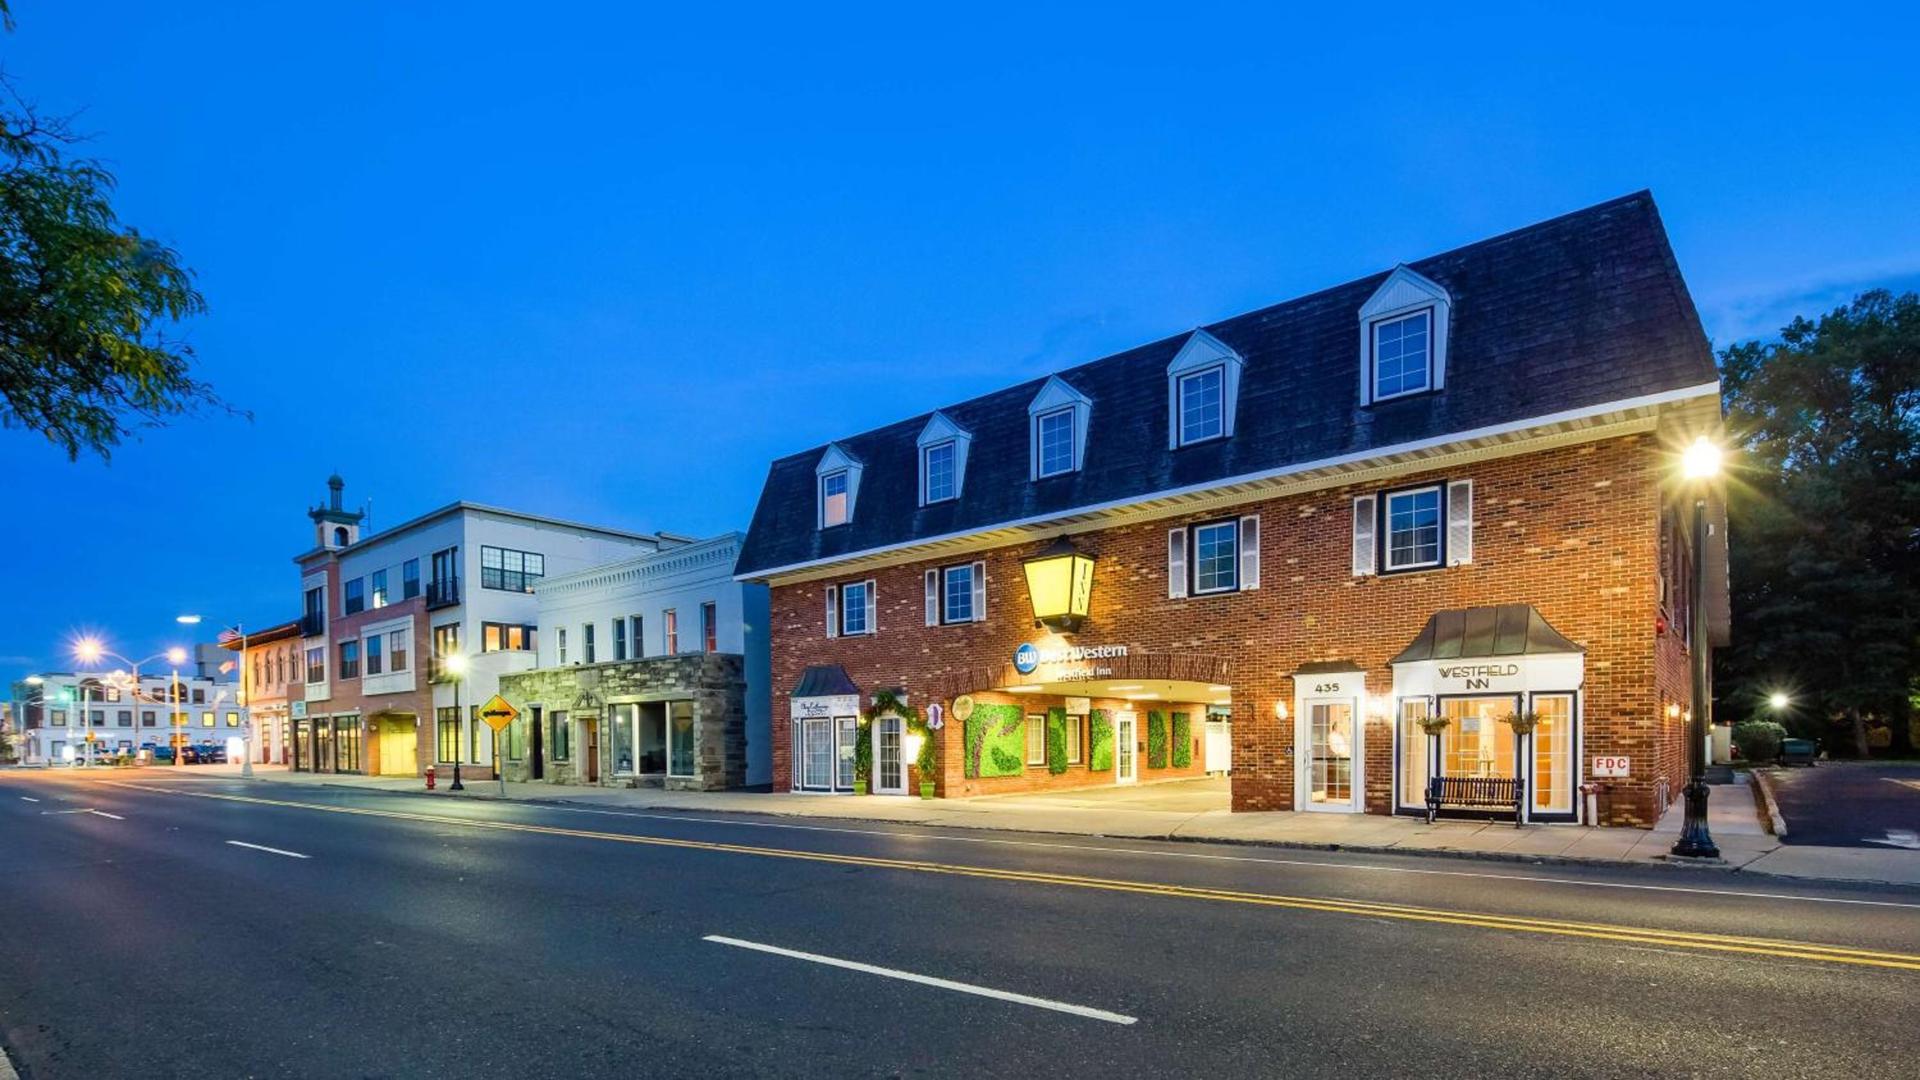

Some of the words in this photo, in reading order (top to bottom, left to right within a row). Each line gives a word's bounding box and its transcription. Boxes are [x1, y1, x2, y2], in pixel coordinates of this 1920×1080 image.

[1018, 651, 1037, 664] BW
[1071, 645, 1128, 660] Western
[1096, 667, 1112, 676] Inn
[1438, 664, 1519, 678] WESTFIELD
[1315, 682, 1340, 692] 435
[1466, 679, 1489, 689] INN
[1596, 758, 1626, 769] FDC
